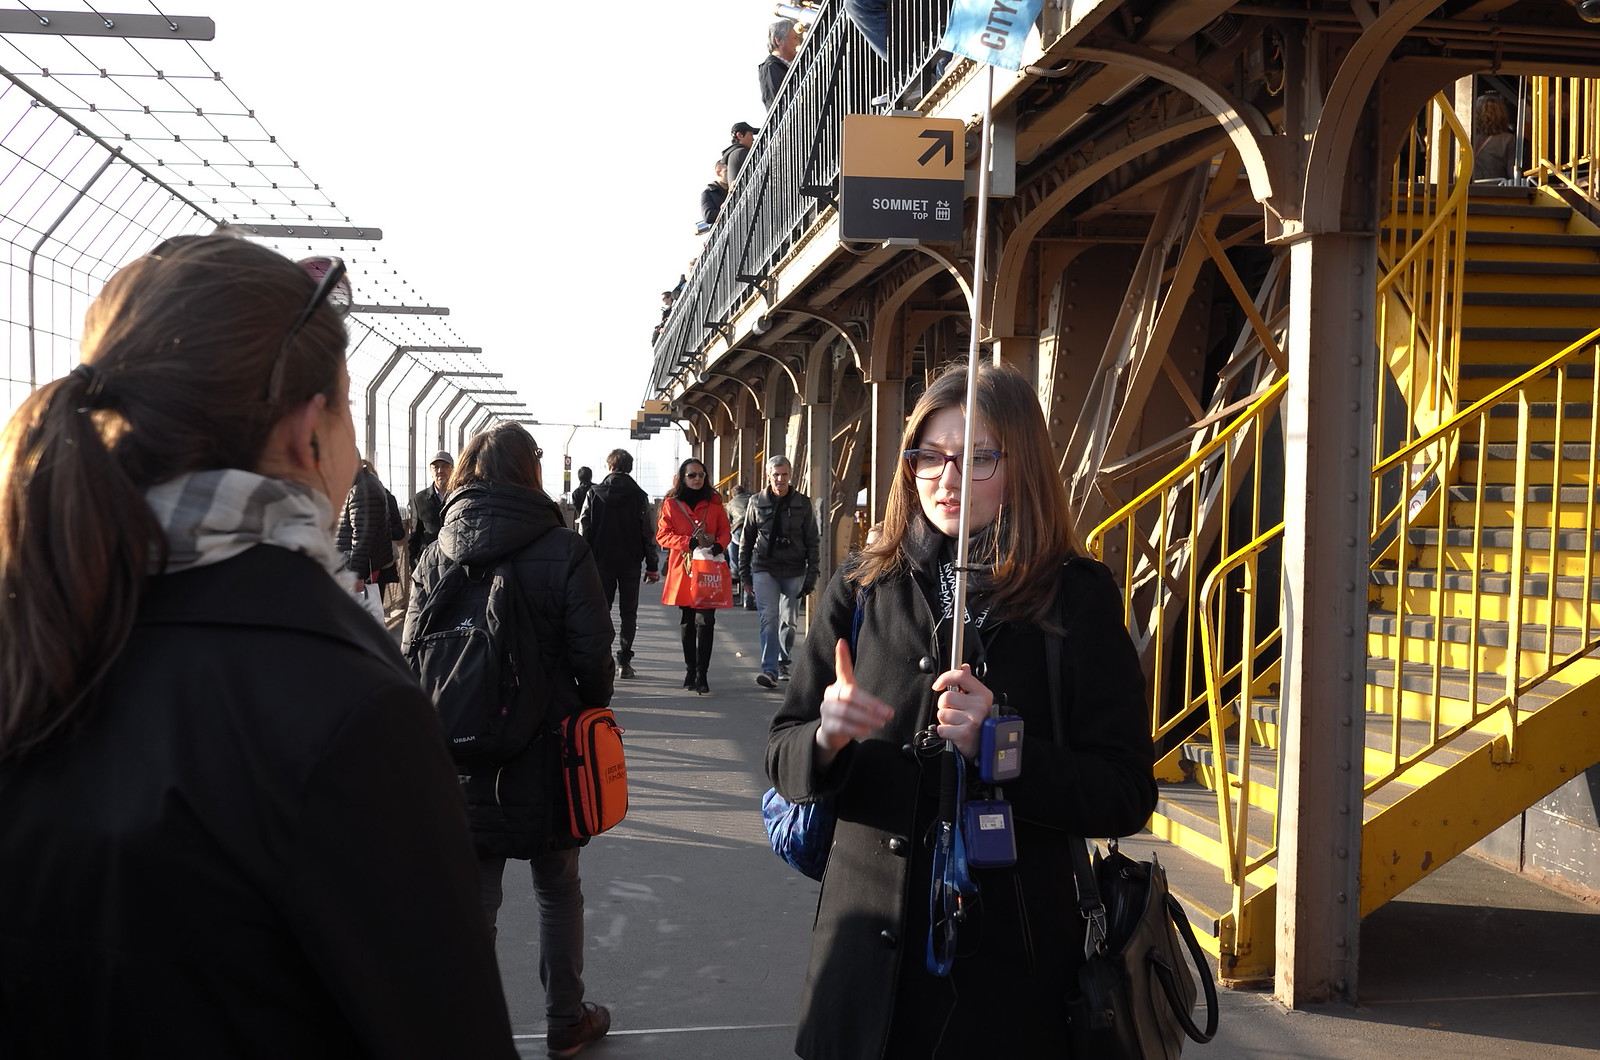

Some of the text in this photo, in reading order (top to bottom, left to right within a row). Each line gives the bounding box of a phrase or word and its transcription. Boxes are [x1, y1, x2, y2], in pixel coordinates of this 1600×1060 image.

[980, 0, 1022, 50] CITY
[872, 198, 929, 212] SOMMET
[912, 211, 929, 220] TOP
